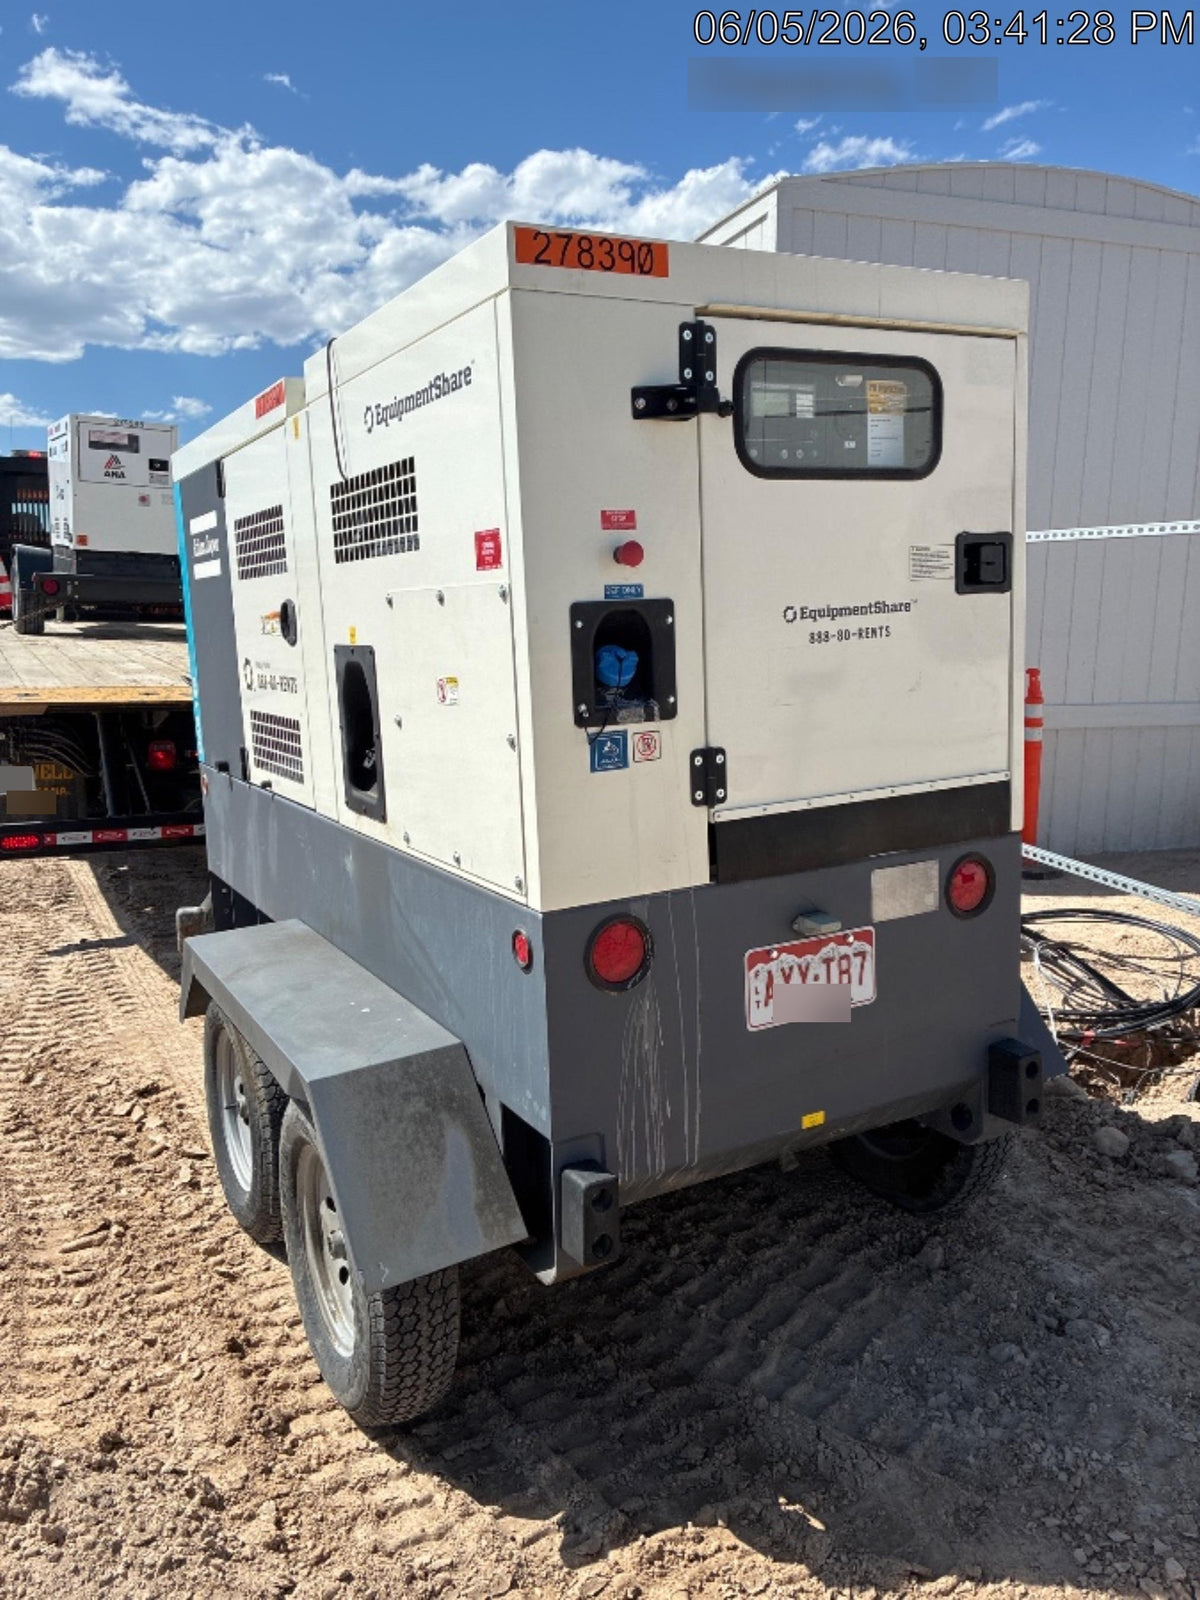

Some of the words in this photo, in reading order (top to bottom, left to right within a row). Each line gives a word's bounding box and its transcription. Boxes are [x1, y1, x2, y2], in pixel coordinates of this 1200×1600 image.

[533, 230, 654, 275] 278390
[375, 365, 473, 427] EquipmentShare
[799, 600, 912, 622] EquipmentShare
[808, 625, 891, 644] 888-80-RENTS
